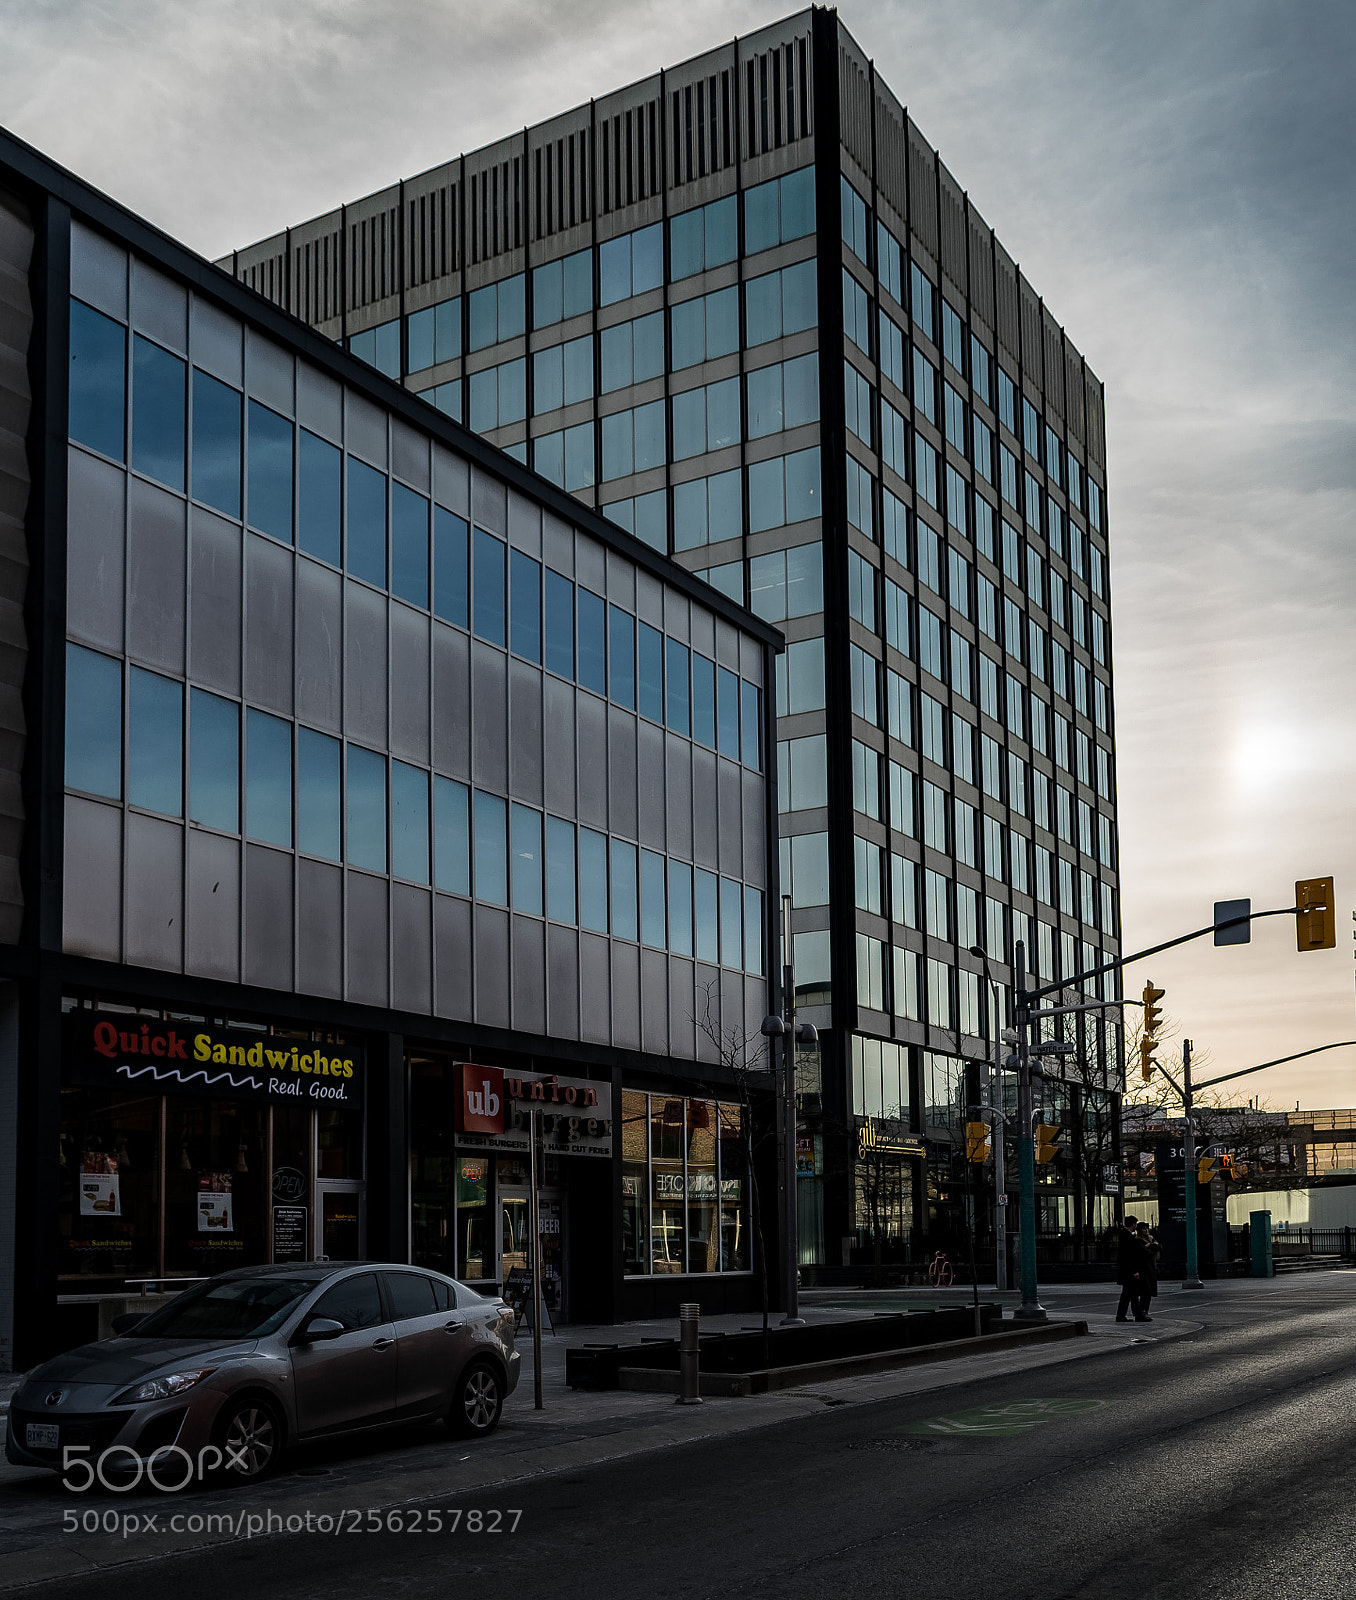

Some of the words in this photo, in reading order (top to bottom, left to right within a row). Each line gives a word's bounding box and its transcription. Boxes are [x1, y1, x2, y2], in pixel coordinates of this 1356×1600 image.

[93, 1021, 188, 1059] Quick
[194, 1033, 353, 1078] Sandwiches
[269, 1077, 303, 1096] Real.
[310, 1081, 349, 1100] Good.
[467, 1080, 500, 1117] ub
[508, 1074, 598, 1106] union
[511, 1099, 612, 1142] brger
[457, 1136, 487, 1147] FRESH
[489, 1139, 528, 1149] BURGERS
[548, 1143, 570, 1152] HAND
[572, 1145, 587, 1153] CUT
[589, 1147, 610, 1155] FRIES
[272, 1174, 305, 1195] OPEN
[461, 1167, 482, 1180] OPEN
[540, 1219, 560, 1234] BEER
